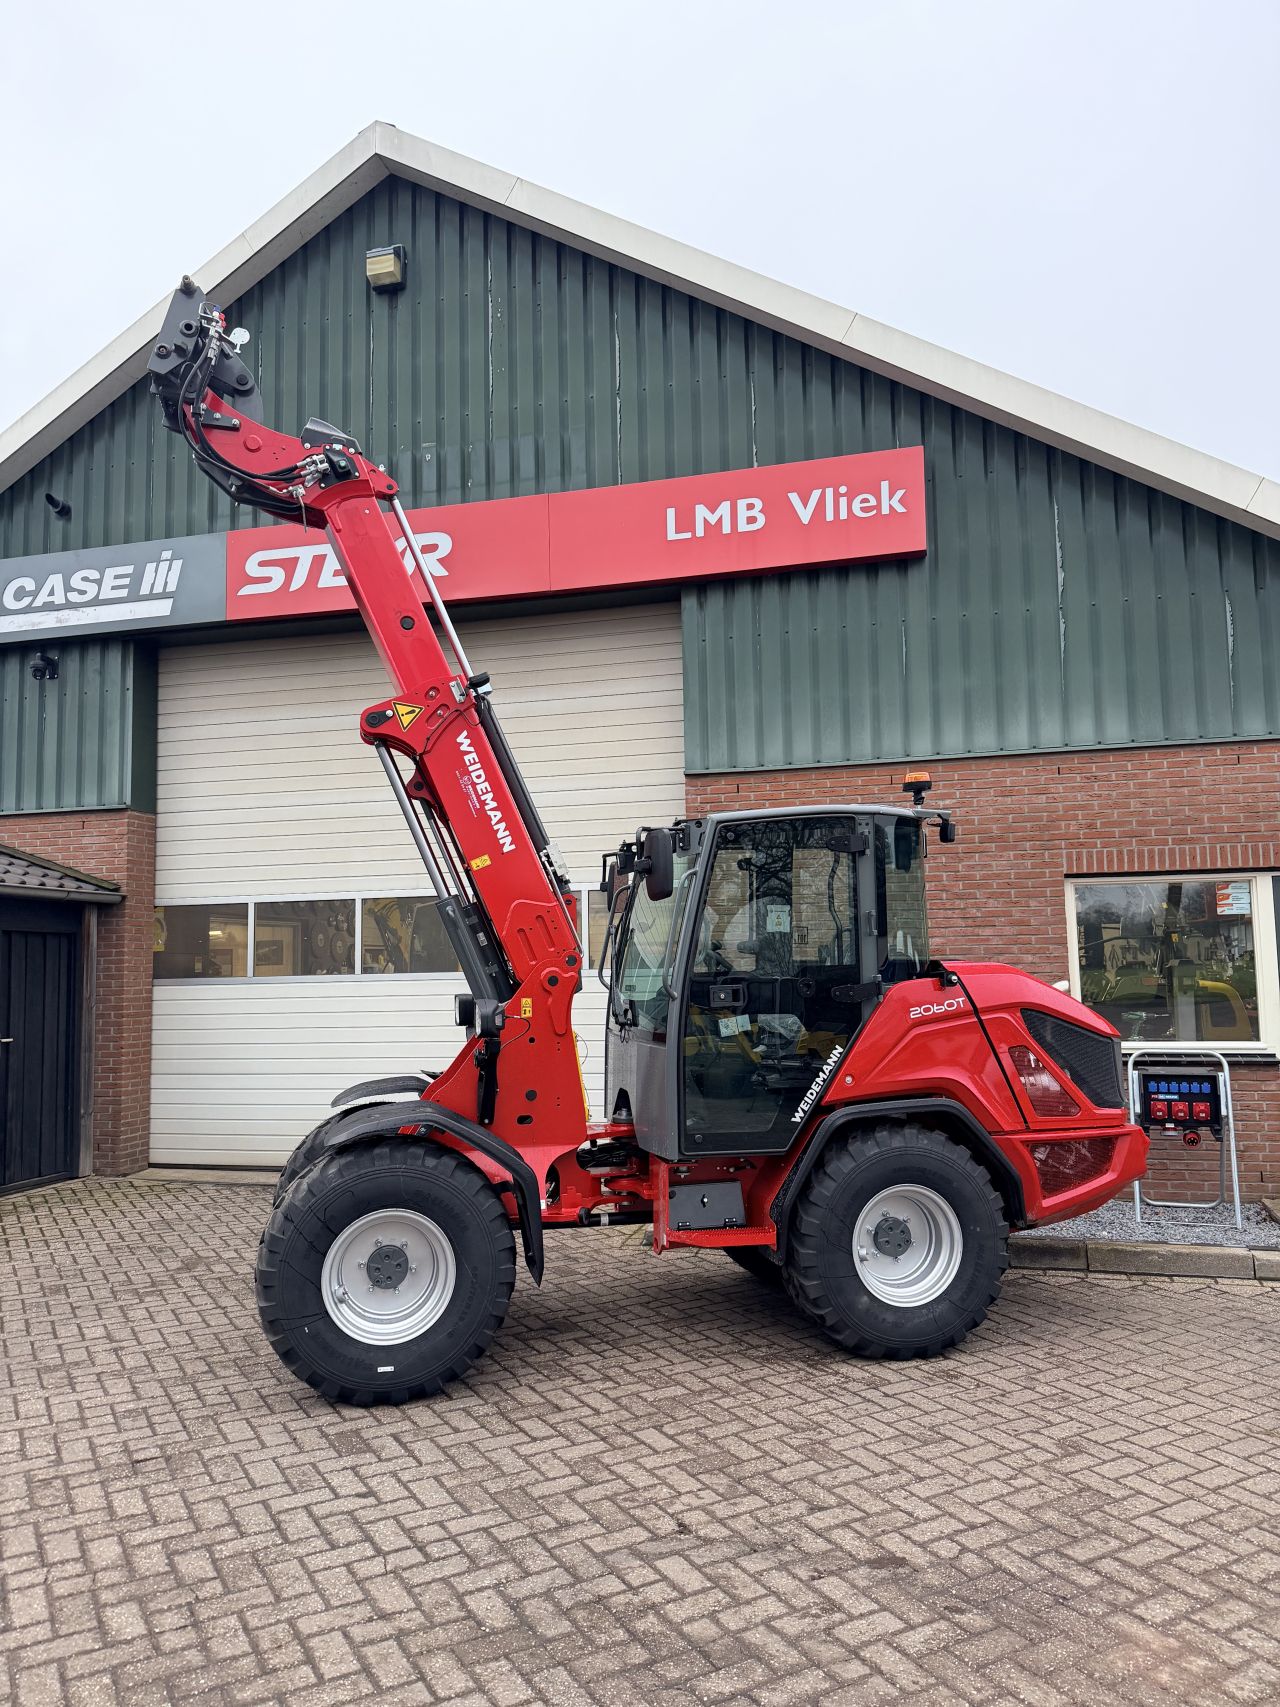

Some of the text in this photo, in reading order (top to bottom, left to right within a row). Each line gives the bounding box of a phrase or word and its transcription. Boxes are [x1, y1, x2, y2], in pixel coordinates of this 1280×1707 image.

[666, 480, 907, 541] LMB Vliek
[2, 565, 134, 610] CASE
[236, 531, 453, 596] STER
[456, 730, 516, 853] WEIDEMANN
[909, 997, 965, 1019] 2060T
[790, 1044, 844, 1124] WEIDEMANN
